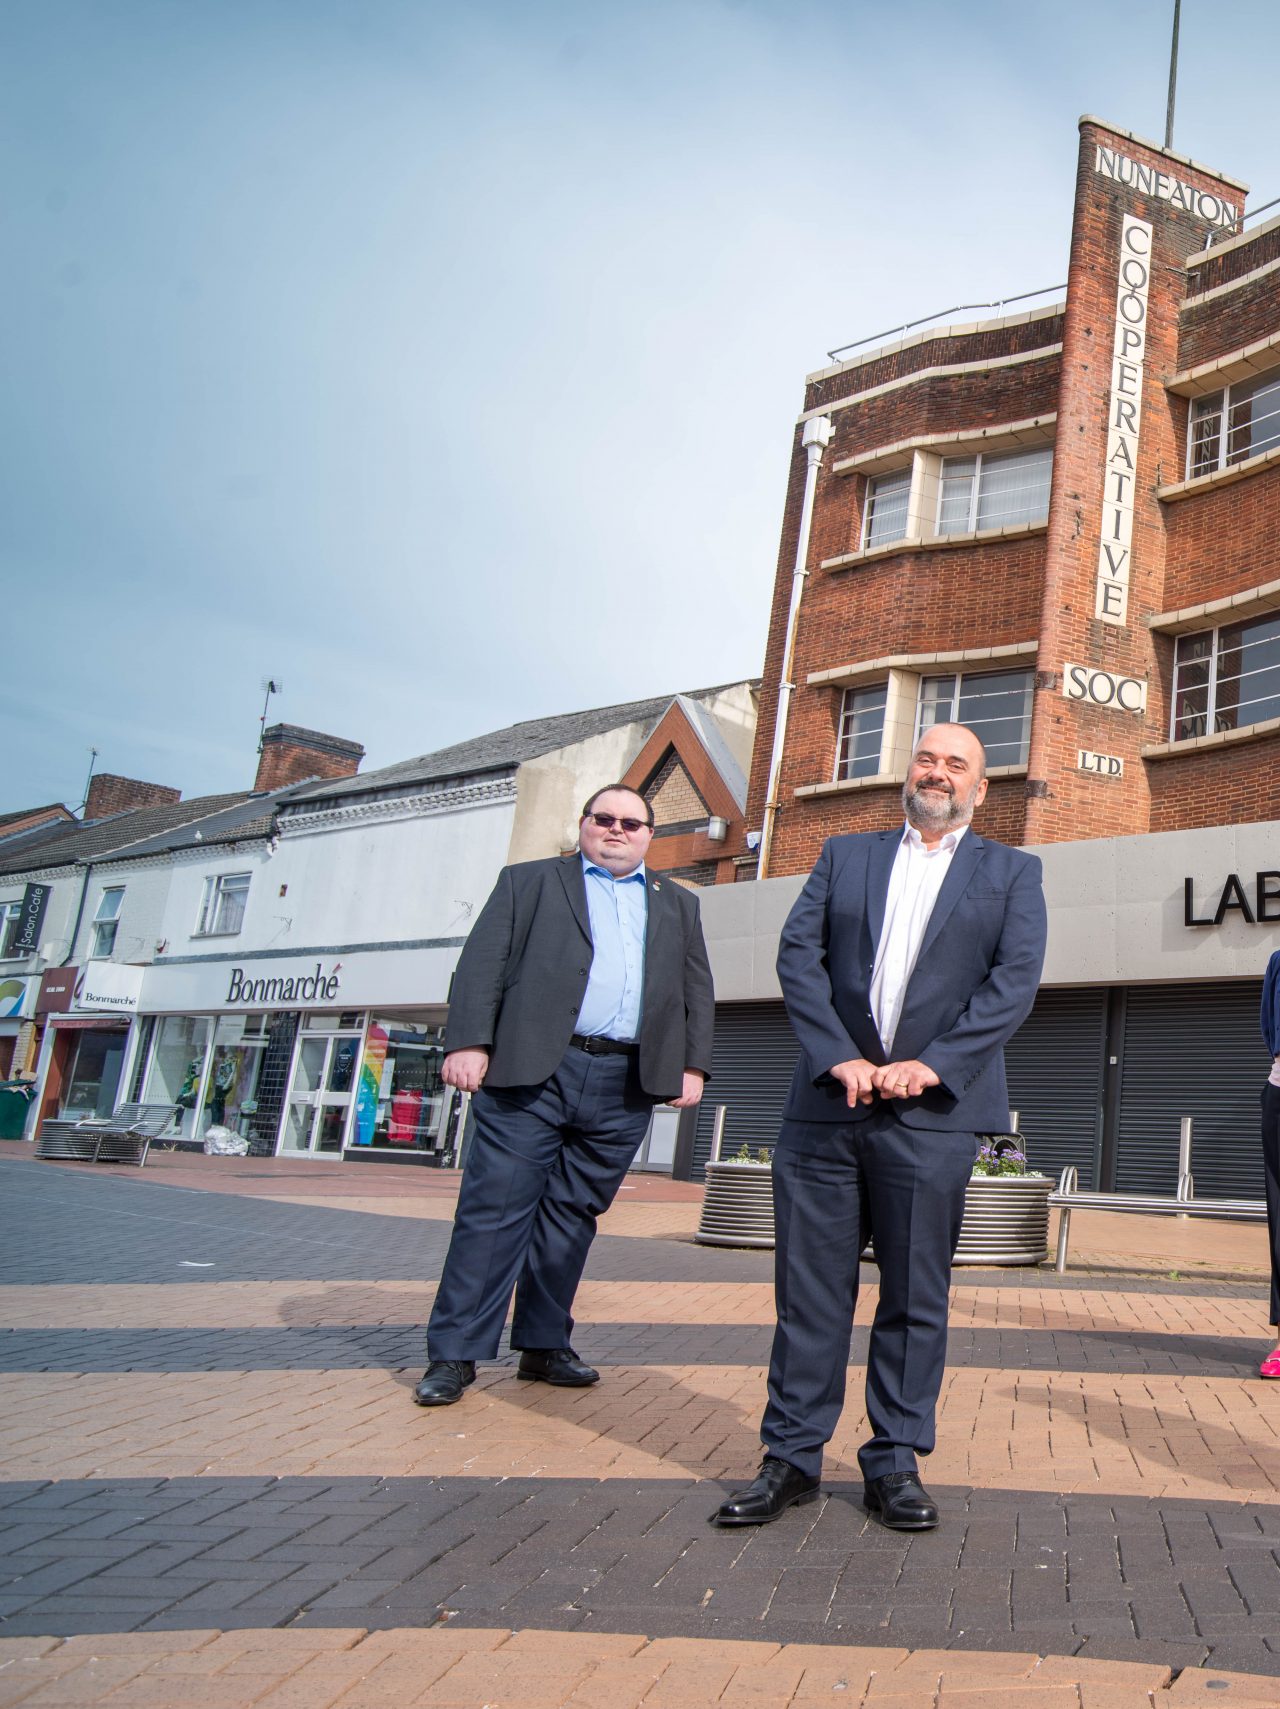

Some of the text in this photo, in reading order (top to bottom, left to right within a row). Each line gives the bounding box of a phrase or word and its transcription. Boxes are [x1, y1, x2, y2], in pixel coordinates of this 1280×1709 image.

[1098, 146, 1238, 232] NUNEATON
[85, 992, 137, 1006] Bonmarché
[225, 963, 342, 1003] Bonmarché
